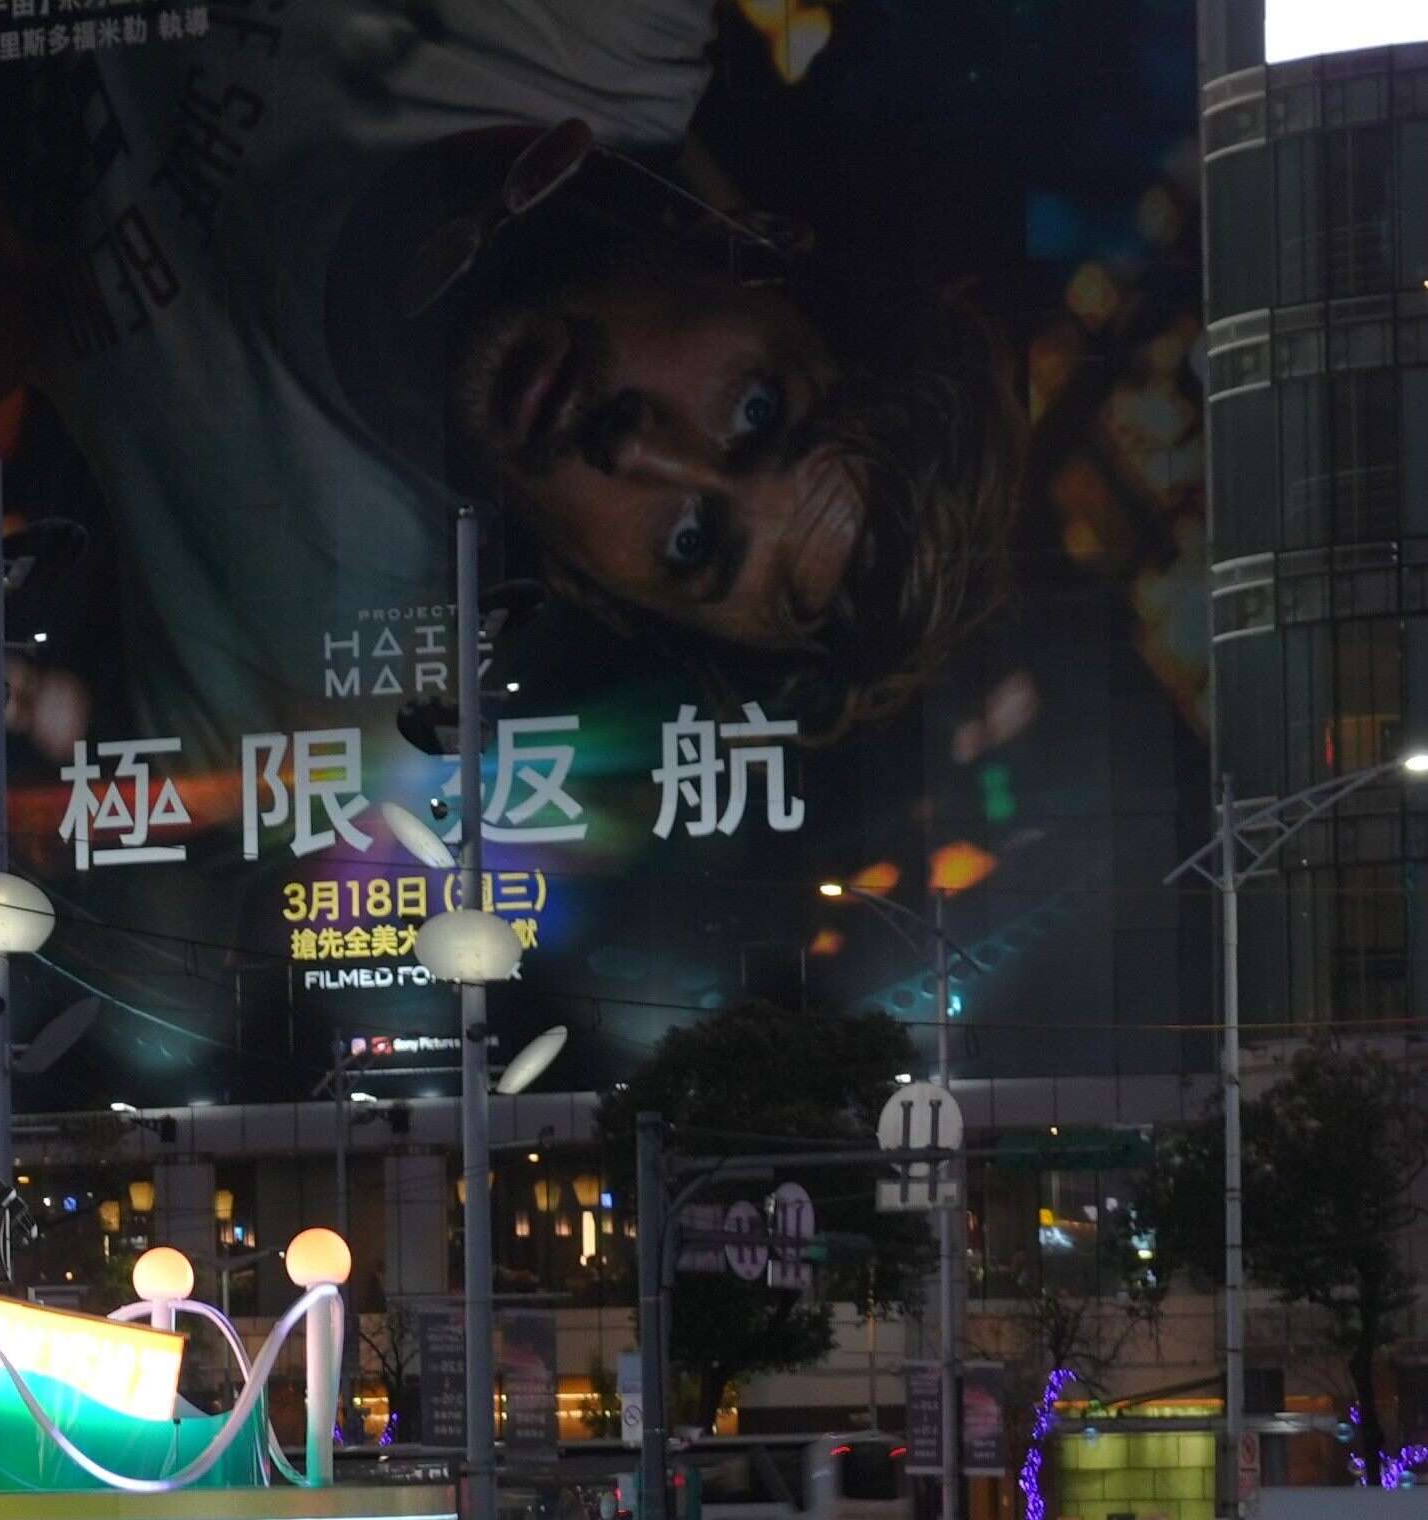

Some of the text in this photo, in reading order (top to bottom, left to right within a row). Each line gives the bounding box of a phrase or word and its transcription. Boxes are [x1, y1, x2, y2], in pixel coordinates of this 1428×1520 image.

[357, 603, 457, 622] PROJECT
[57, 700, 807, 872] 極限返航
[282, 876, 427, 922] 3月18日
[304, 964, 393, 990] FILMED
